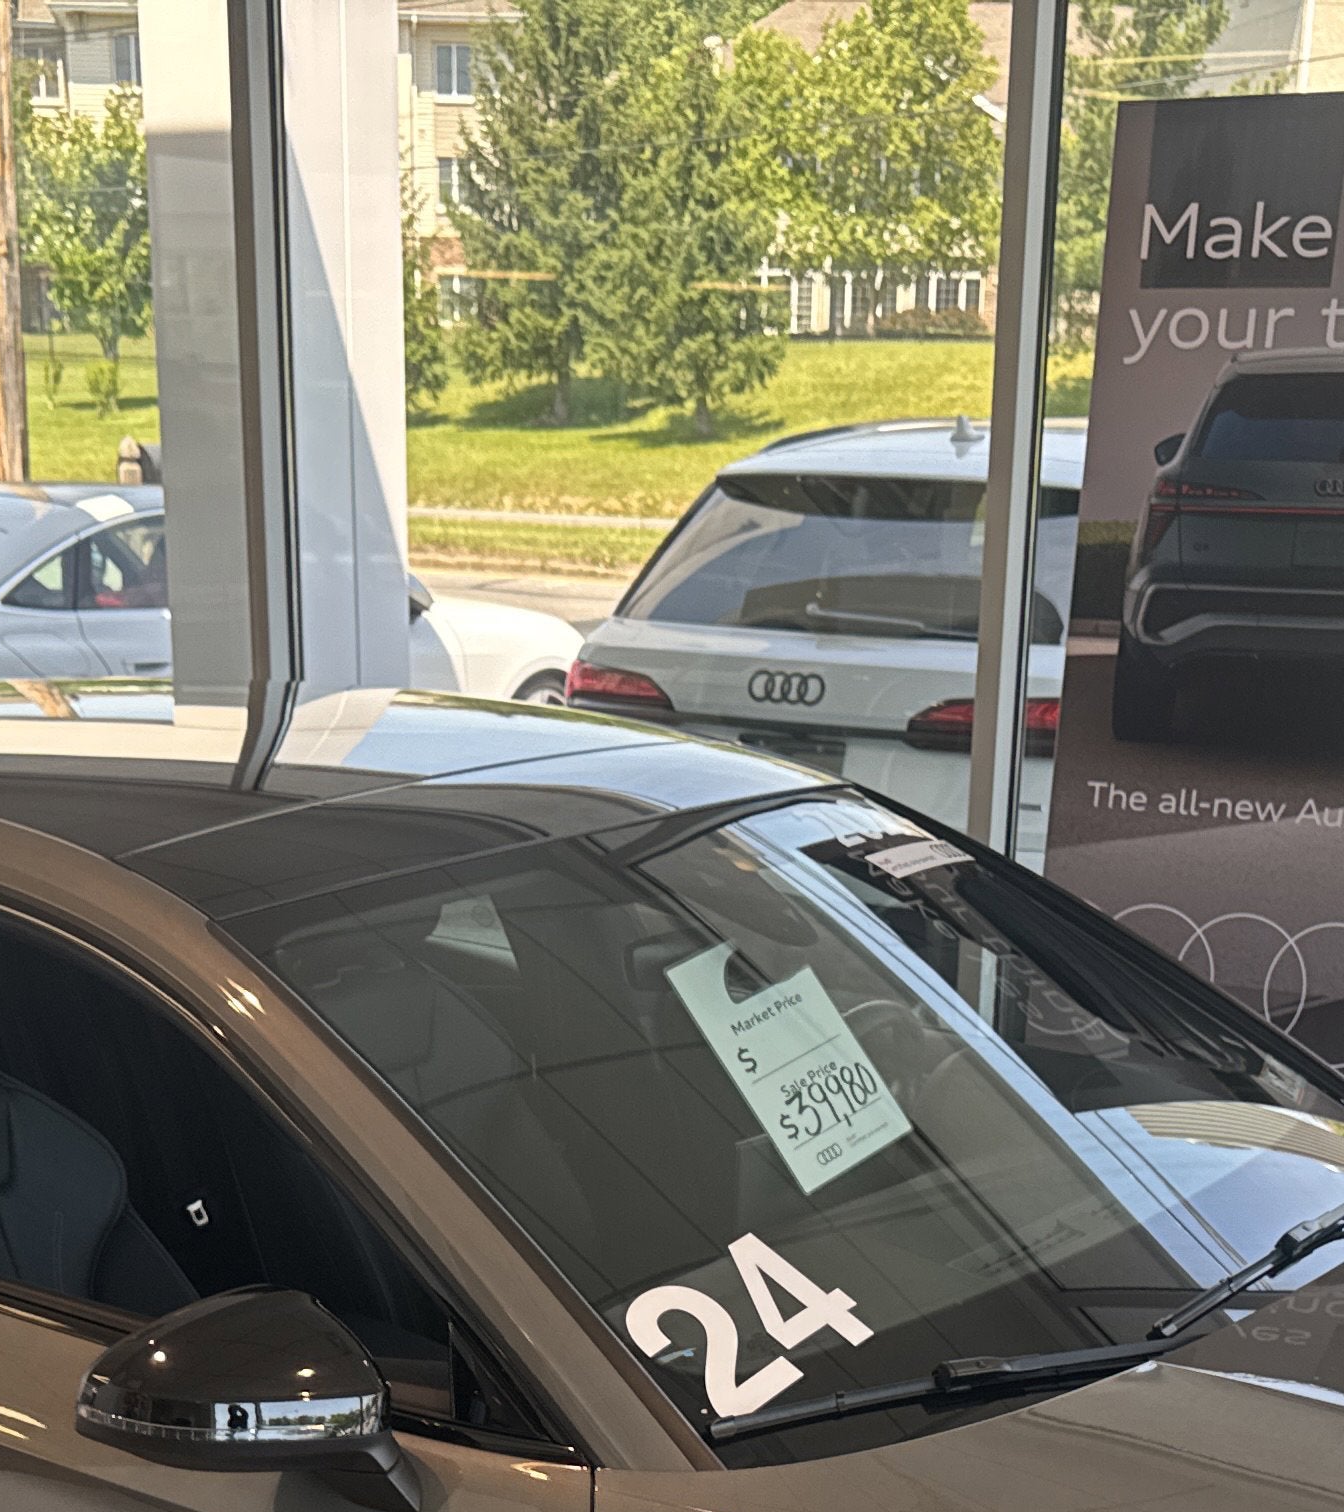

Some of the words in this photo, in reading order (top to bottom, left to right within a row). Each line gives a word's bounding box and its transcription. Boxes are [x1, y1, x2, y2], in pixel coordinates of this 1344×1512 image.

[1140, 201, 1333, 261] Make
[1123, 306, 1296, 365] your
[1087, 780, 1148, 812] The
[1158, 788, 1286, 823] all-new
[730, 1007, 775, 1037] Market
[773, 991, 804, 1015] Price
[780, 1076, 808, 1099] Sale
[807, 1060, 839, 1084] Price
[625, 1232, 875, 1418] 24
